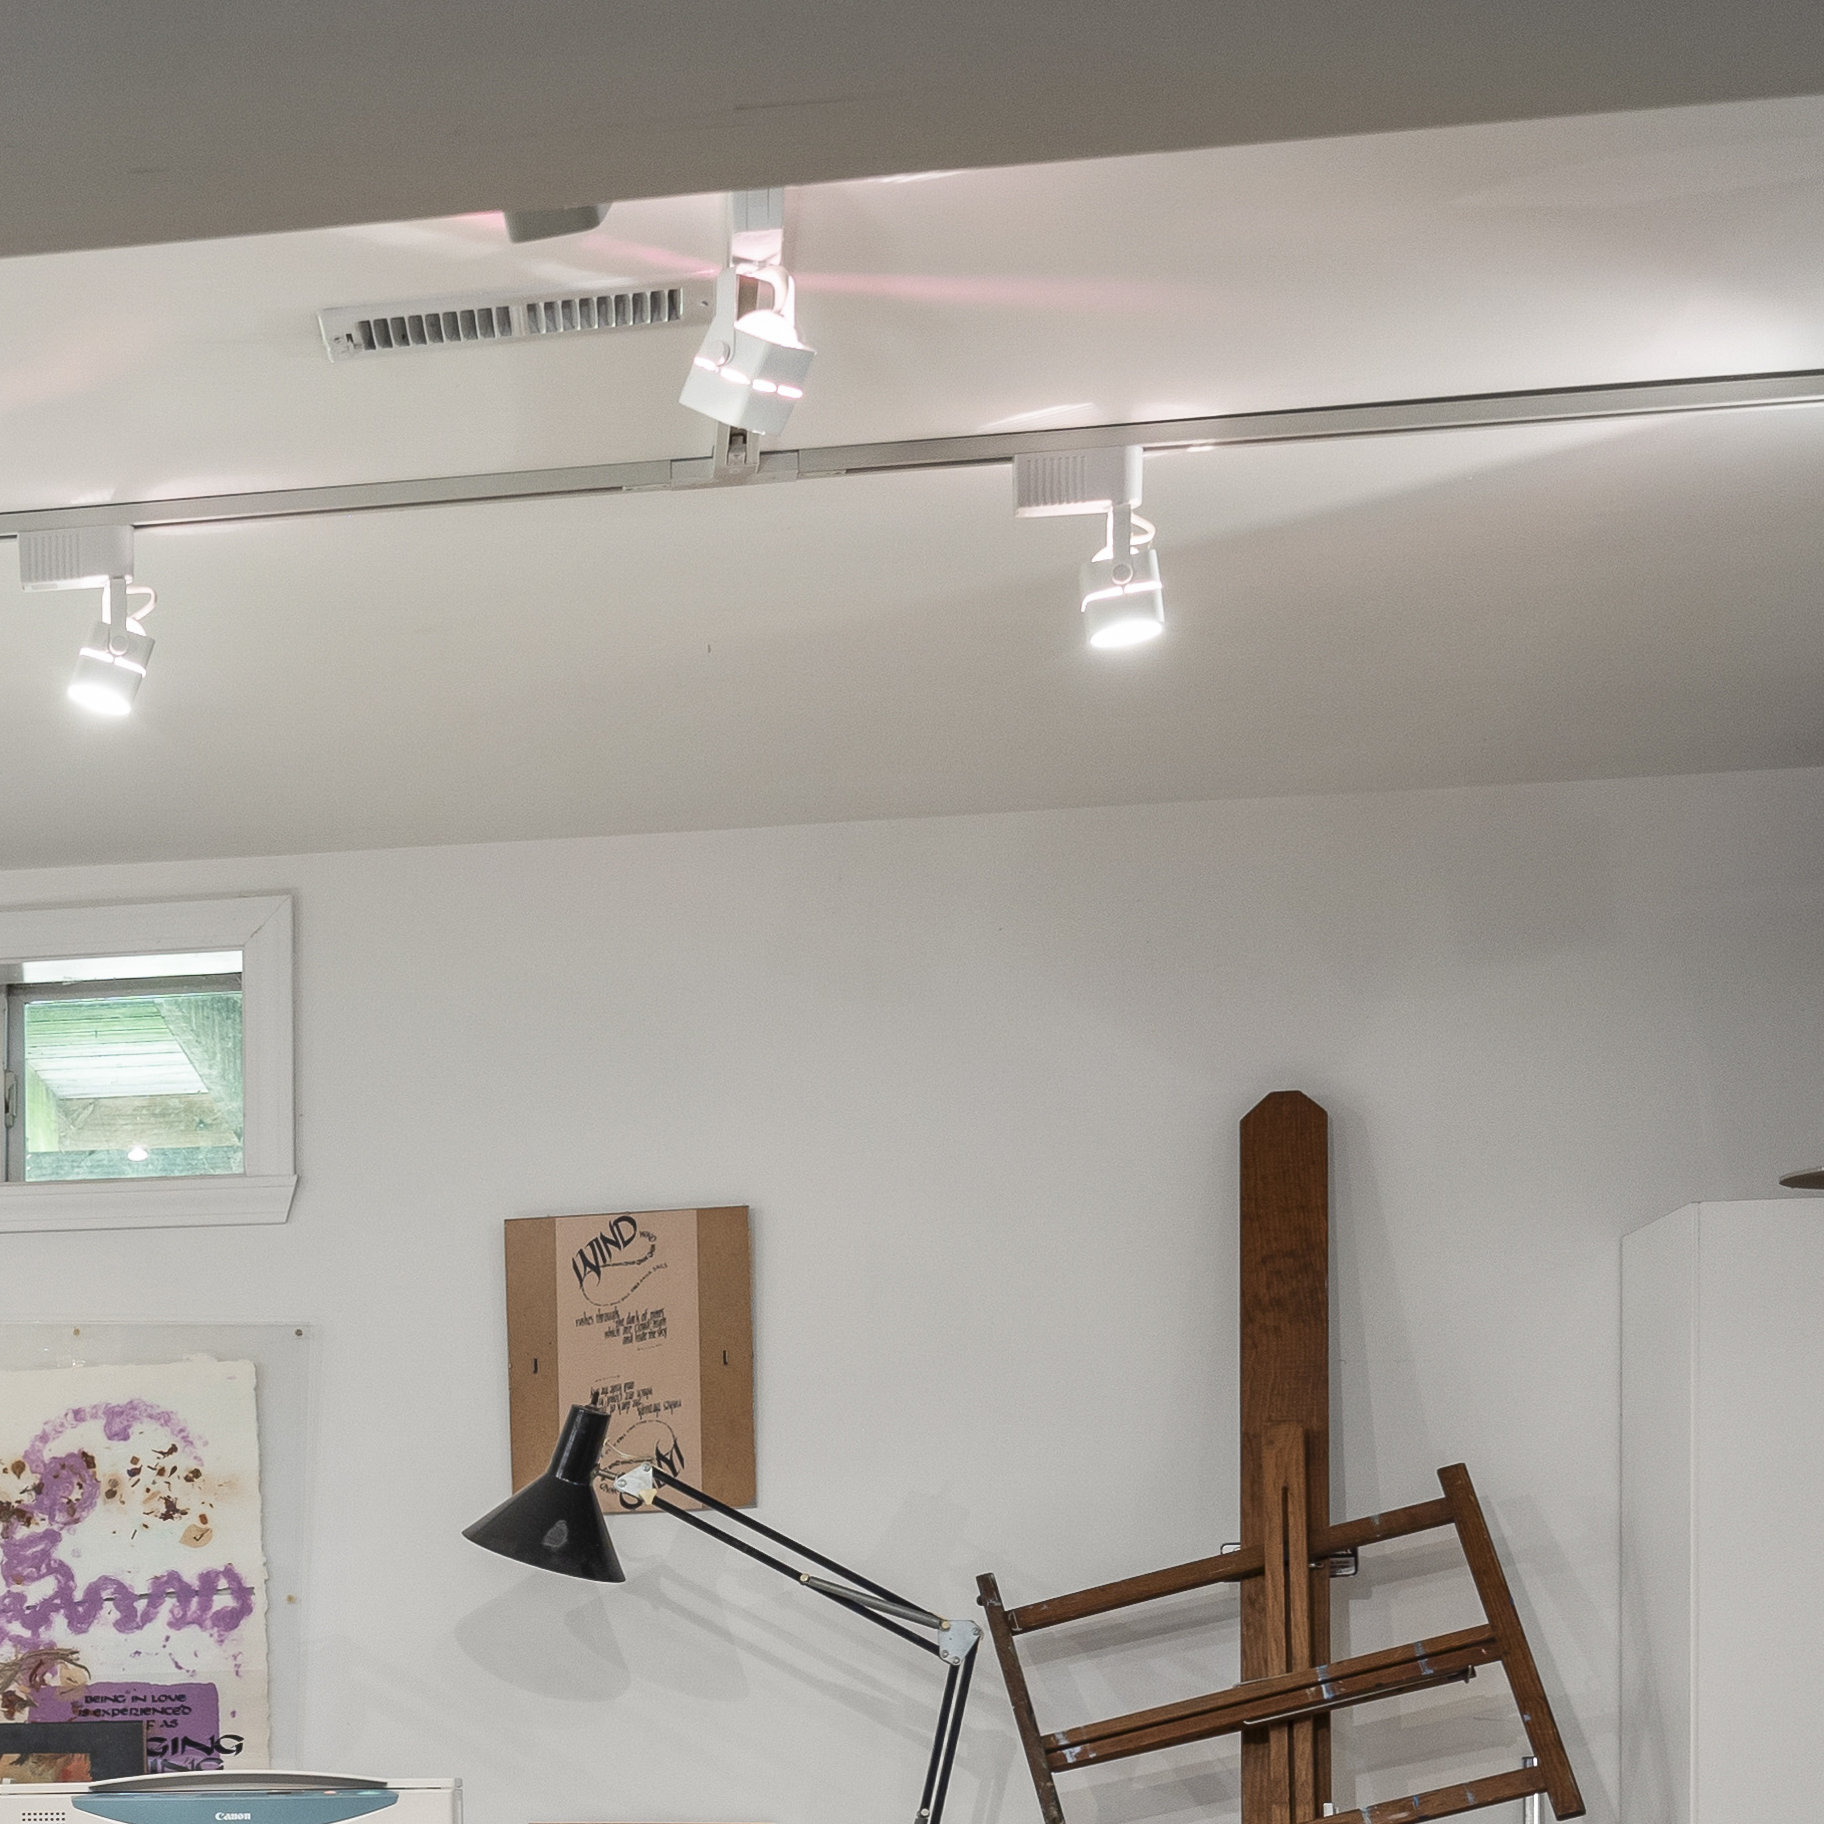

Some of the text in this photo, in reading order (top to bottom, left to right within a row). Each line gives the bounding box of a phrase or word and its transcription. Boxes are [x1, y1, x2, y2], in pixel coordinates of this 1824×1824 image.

[572, 1215, 637, 1289] WIND
[84, 1694, 186, 1703] BEING IN LOVE
[160, 1720, 178, 1728] AS
[215, 1812, 251, 1820] Canon
